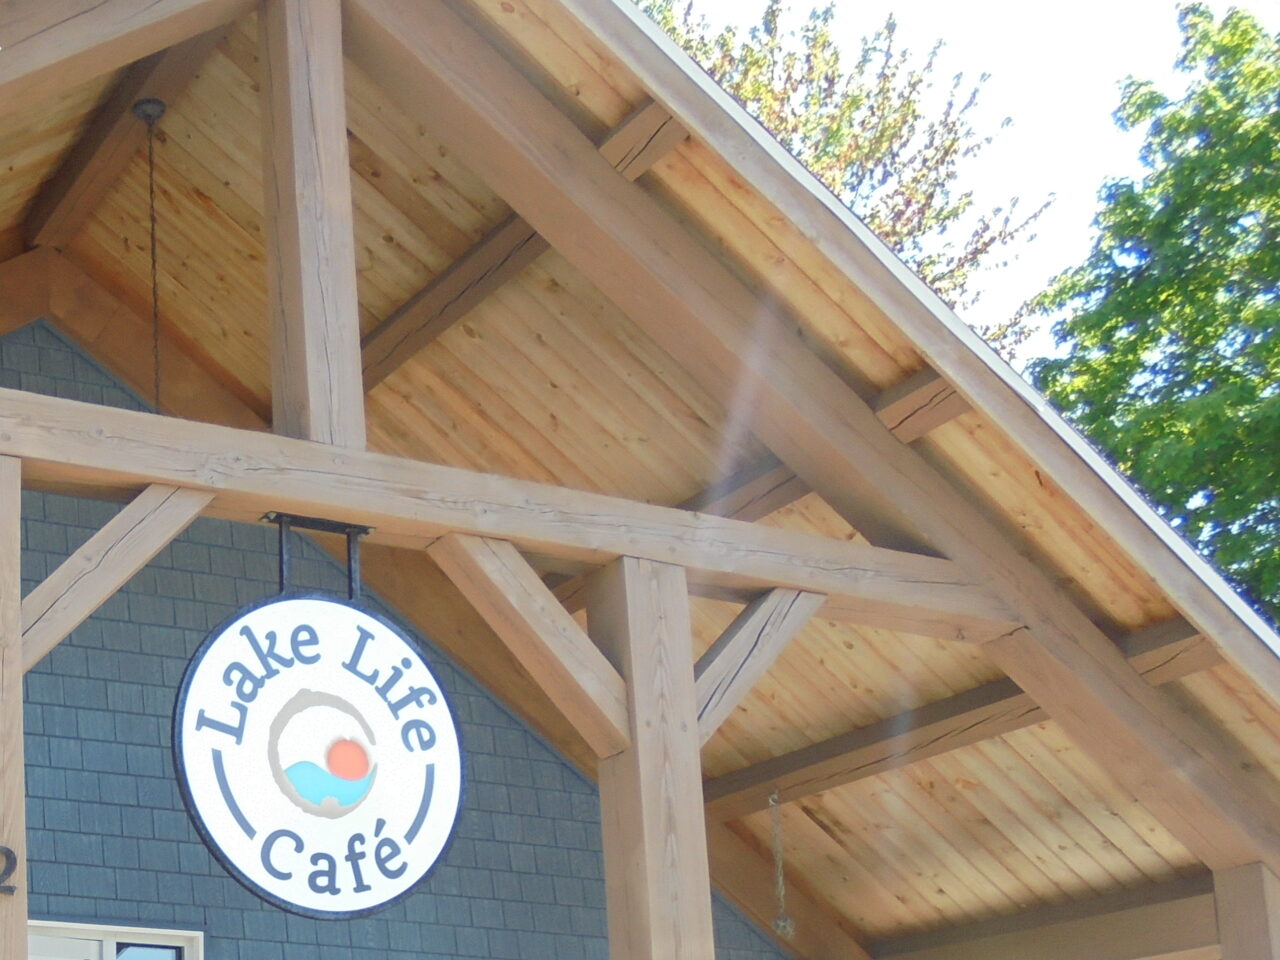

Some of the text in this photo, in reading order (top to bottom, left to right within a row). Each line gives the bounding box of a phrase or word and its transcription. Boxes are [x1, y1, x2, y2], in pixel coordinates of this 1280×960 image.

[195, 623, 438, 753] Lake Life
[260, 817, 408, 896] Café
